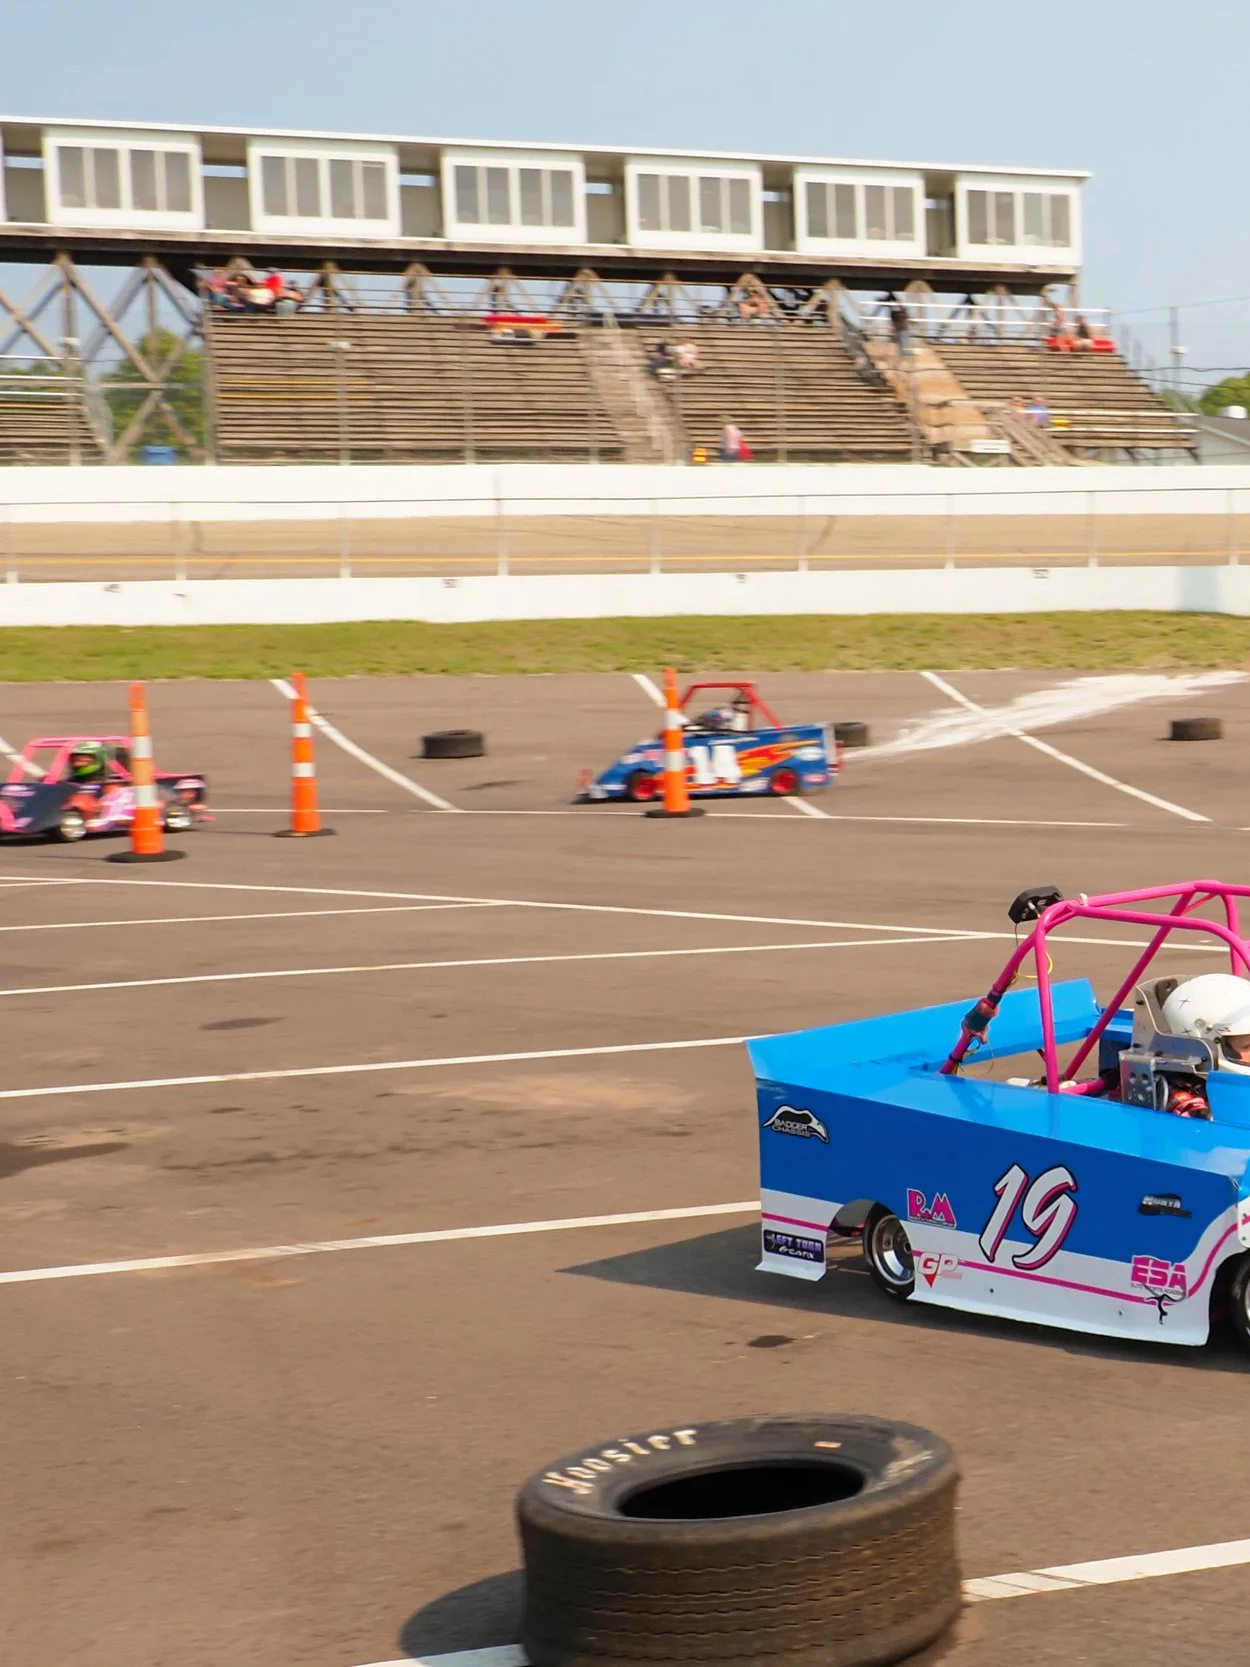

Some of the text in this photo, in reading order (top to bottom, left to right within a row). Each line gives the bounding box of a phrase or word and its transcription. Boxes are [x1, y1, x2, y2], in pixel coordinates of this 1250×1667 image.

[979, 1162, 1079, 1271] 19
[770, 1233, 793, 1247] LEFT
[917, 1252, 960, 1277] GP
[1131, 1255, 1187, 1291] ESA
